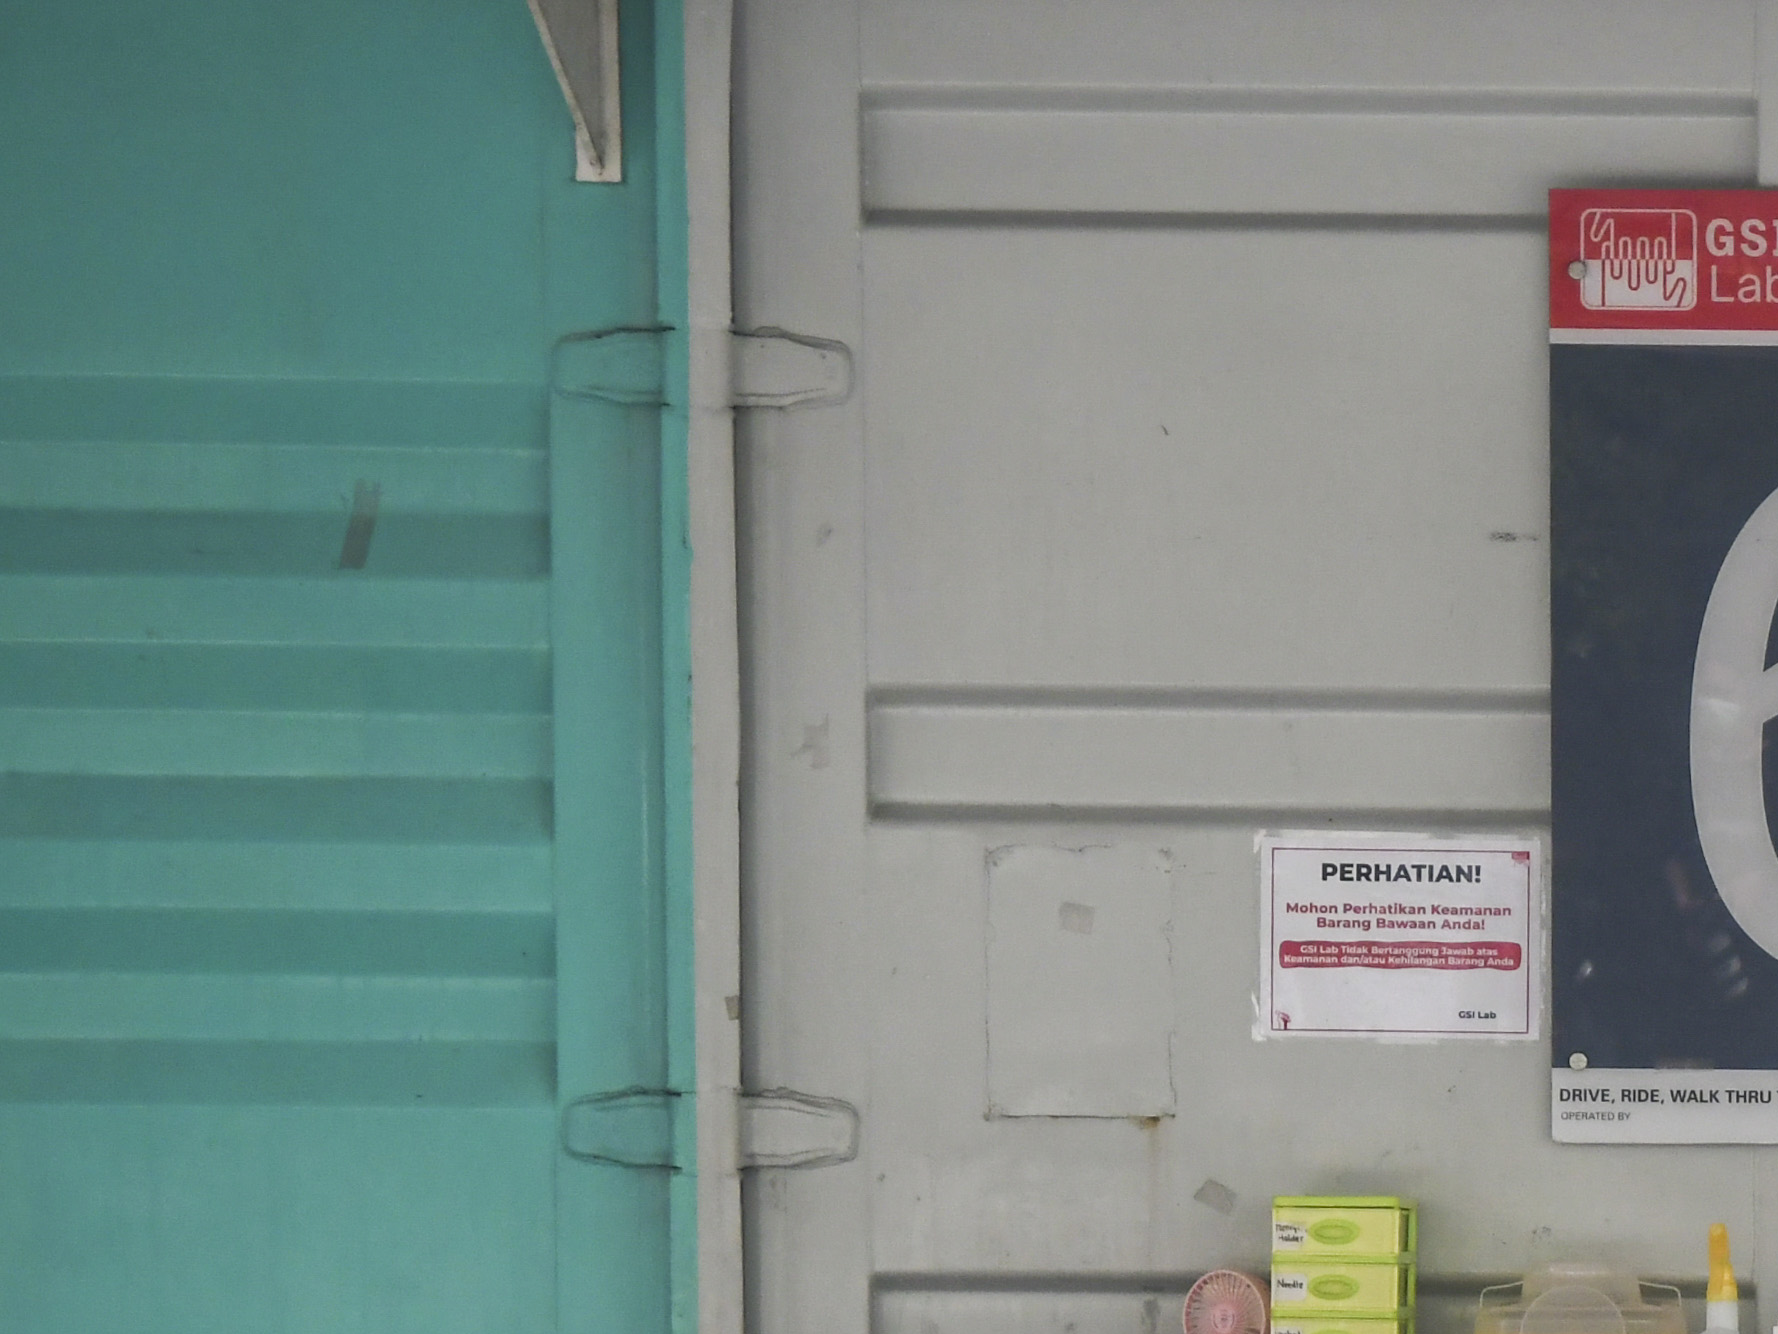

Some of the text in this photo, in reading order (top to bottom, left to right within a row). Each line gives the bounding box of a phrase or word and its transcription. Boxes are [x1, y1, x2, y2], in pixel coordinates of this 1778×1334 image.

[1321, 862, 1482, 883] PERHATIAN!
[1286, 902, 1512, 916] Mohon Perhatikan Keamanan
[1316, 917, 1485, 931] Barang Bawaan Anda!
[1300, 945, 1498, 957] GSI Lab Tidak Bertanggung Jawab atas
[1284, 954, 1514, 967] Keamanan dan/atau Kehilangan Barang Anda
[1458, 1010, 1497, 1020] GSI Lab
[1559, 1088, 1616, 1104] DRIVE,
[1621, 1089, 1665, 1104] RIDE,
[1670, 1090, 1720, 1103] WALK
[1725, 1090, 1772, 1104] THRU
[1561, 1112, 1631, 1121] OPERATED BY
